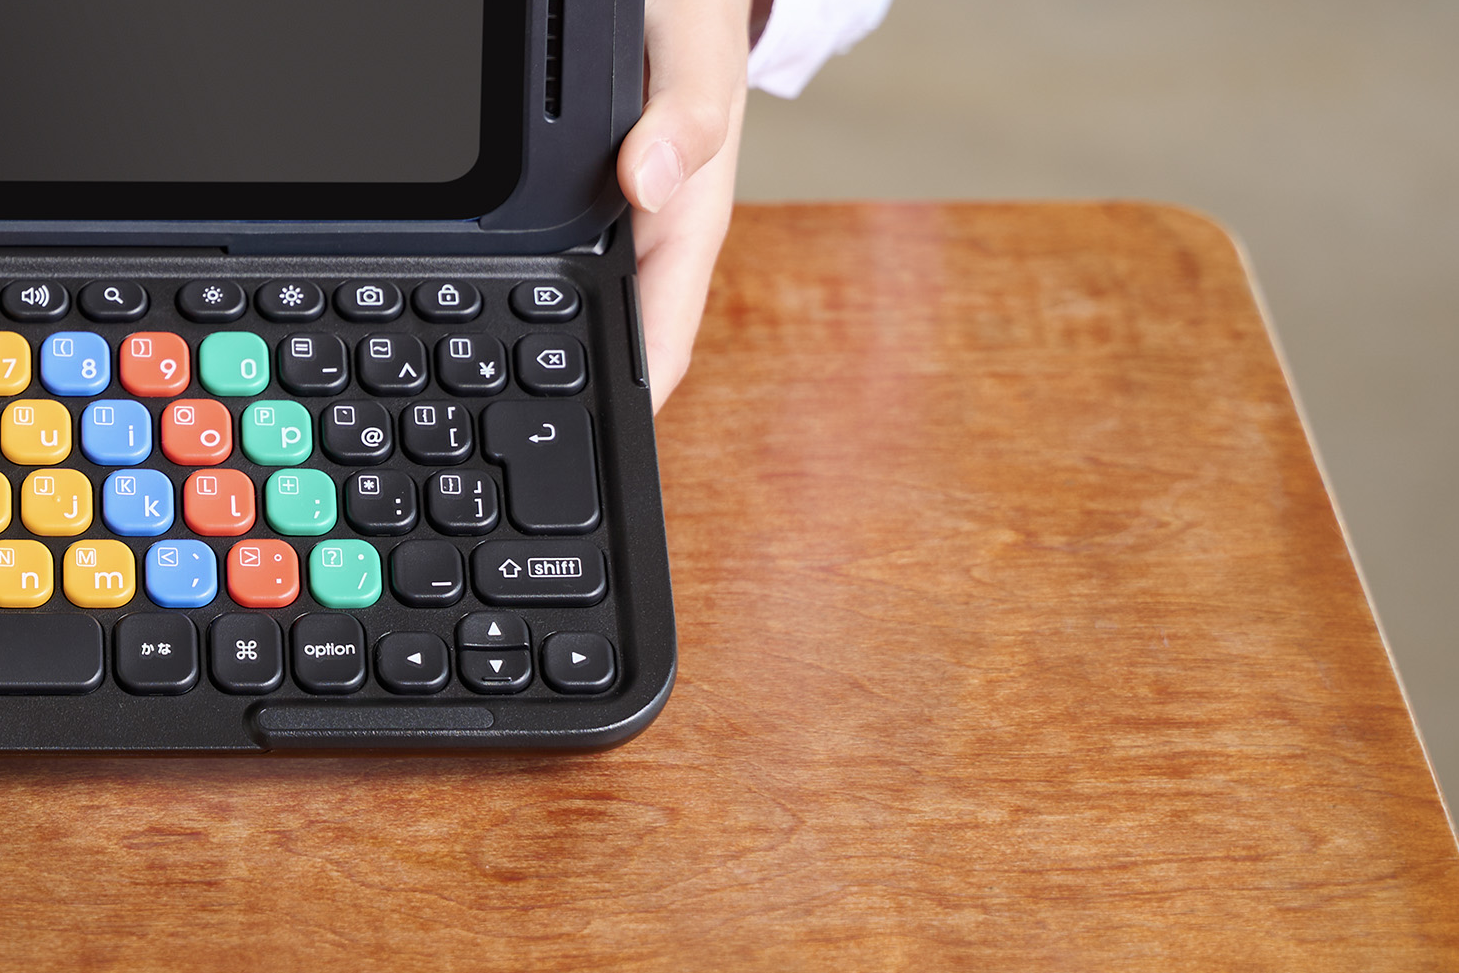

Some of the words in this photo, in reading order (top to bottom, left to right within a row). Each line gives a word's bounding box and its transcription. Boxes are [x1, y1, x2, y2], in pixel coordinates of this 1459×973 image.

[295, 343, 309, 351] =
[2, 358, 17, 379] 7
[81, 358, 97, 379] 8
[159, 358, 177, 380] 9
[240, 358, 257, 379] 0
[479, 361, 495, 379] ¥
[18, 409, 29, 423] U
[176, 408, 192, 423] O
[259, 409, 270, 423] P
[40, 429, 58, 447] u
[200, 429, 221, 447] o
[281, 426, 302, 449] p
[360, 427, 384, 447] @
[449, 428, 459, 447] [
[39, 479, 48, 493] J
[120, 479, 132, 493] K
[203, 479, 212, 493] L
[282, 479, 295, 491] +
[63, 495, 78, 519] j
[144, 495, 161, 517] k
[313, 499, 321, 519] ;
[474, 498, 483, 518] ]
[78, 550, 94, 565] M
[161, 551, 175, 564] <
[243, 550, 258, 564] >
[327, 550, 337, 565] ?
[534, 560, 575, 575] shift
[21, 571, 39, 590] n
[94, 571, 124, 589] m
[357, 572, 368, 590] /
[141, 642, 172, 656] かな
[304, 642, 356, 658] option
